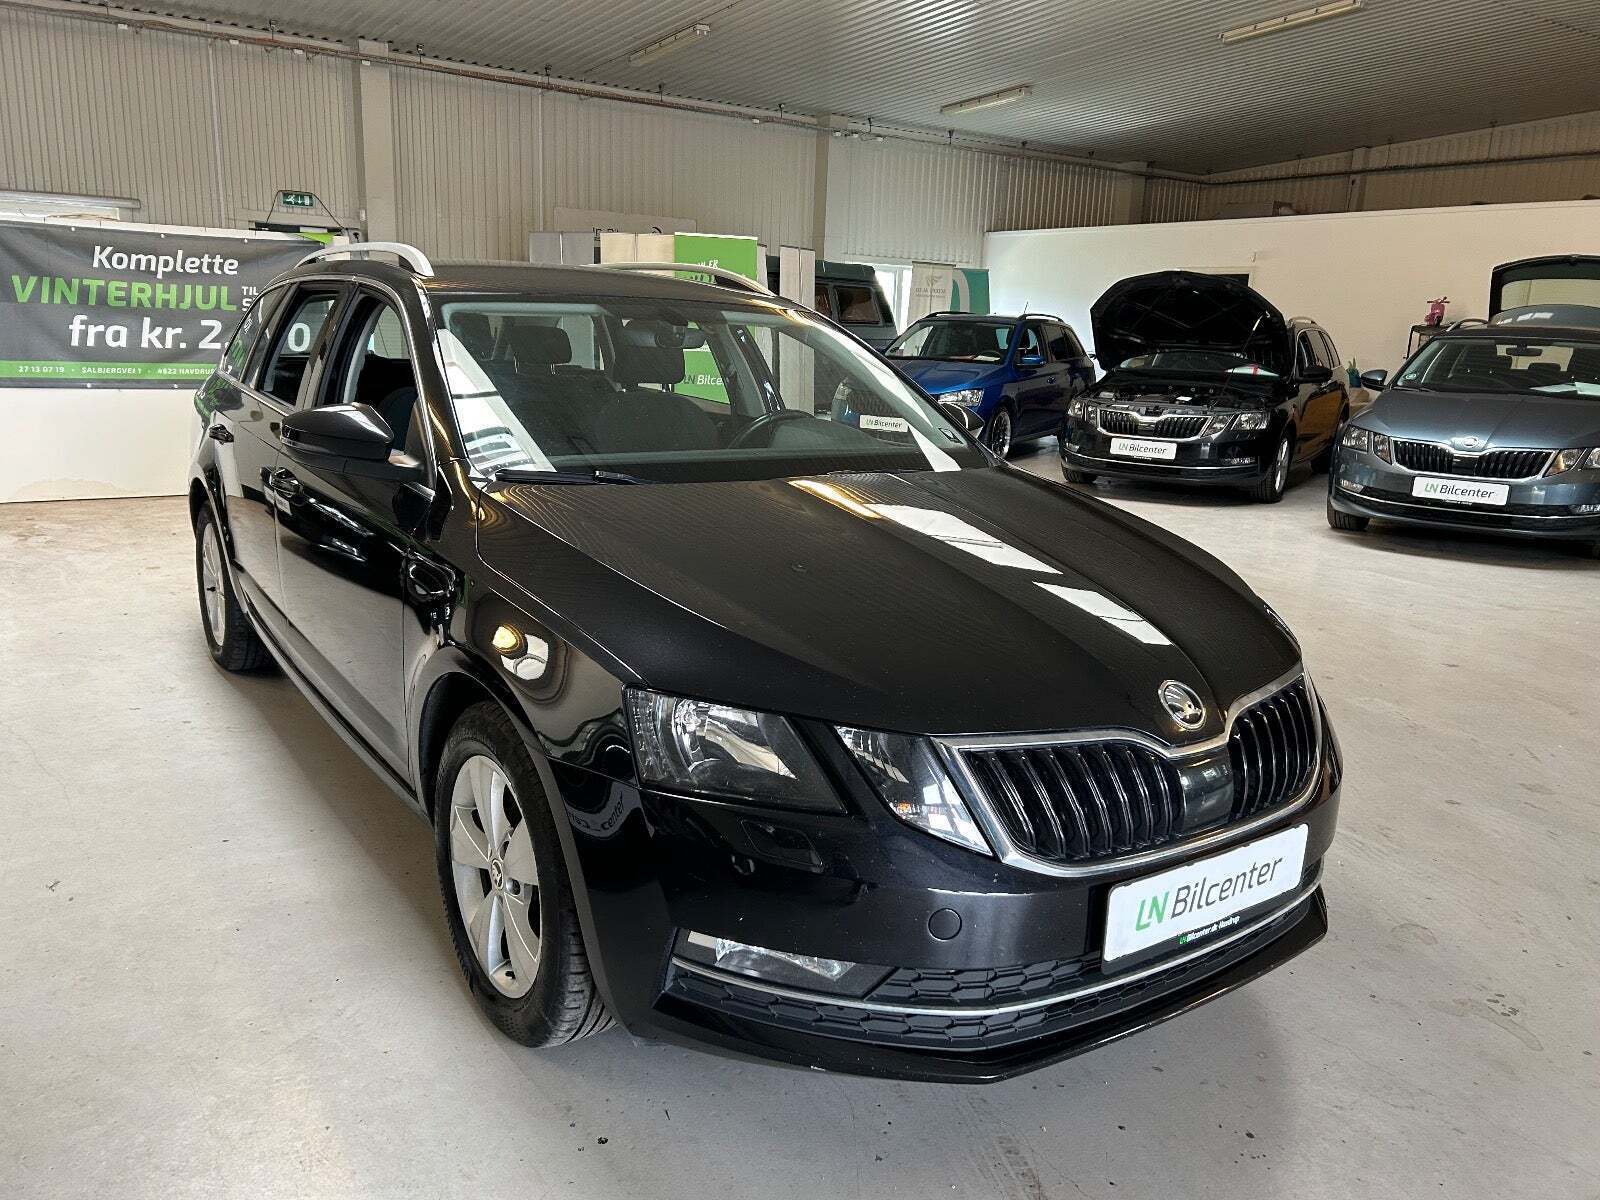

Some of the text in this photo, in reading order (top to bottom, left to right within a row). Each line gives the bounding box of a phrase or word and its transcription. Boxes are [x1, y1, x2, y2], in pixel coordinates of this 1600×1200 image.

[93, 246, 239, 279] Komplette
[11, 275, 237, 311] VINTERHJUL
[68, 314, 128, 347] fra
[140, 317, 187, 349] kr.
[1129, 443, 1167, 455] Bilcenter
[1440, 484, 1495, 499] Bilcenter
[1170, 857, 1284, 919] Bilcenter
